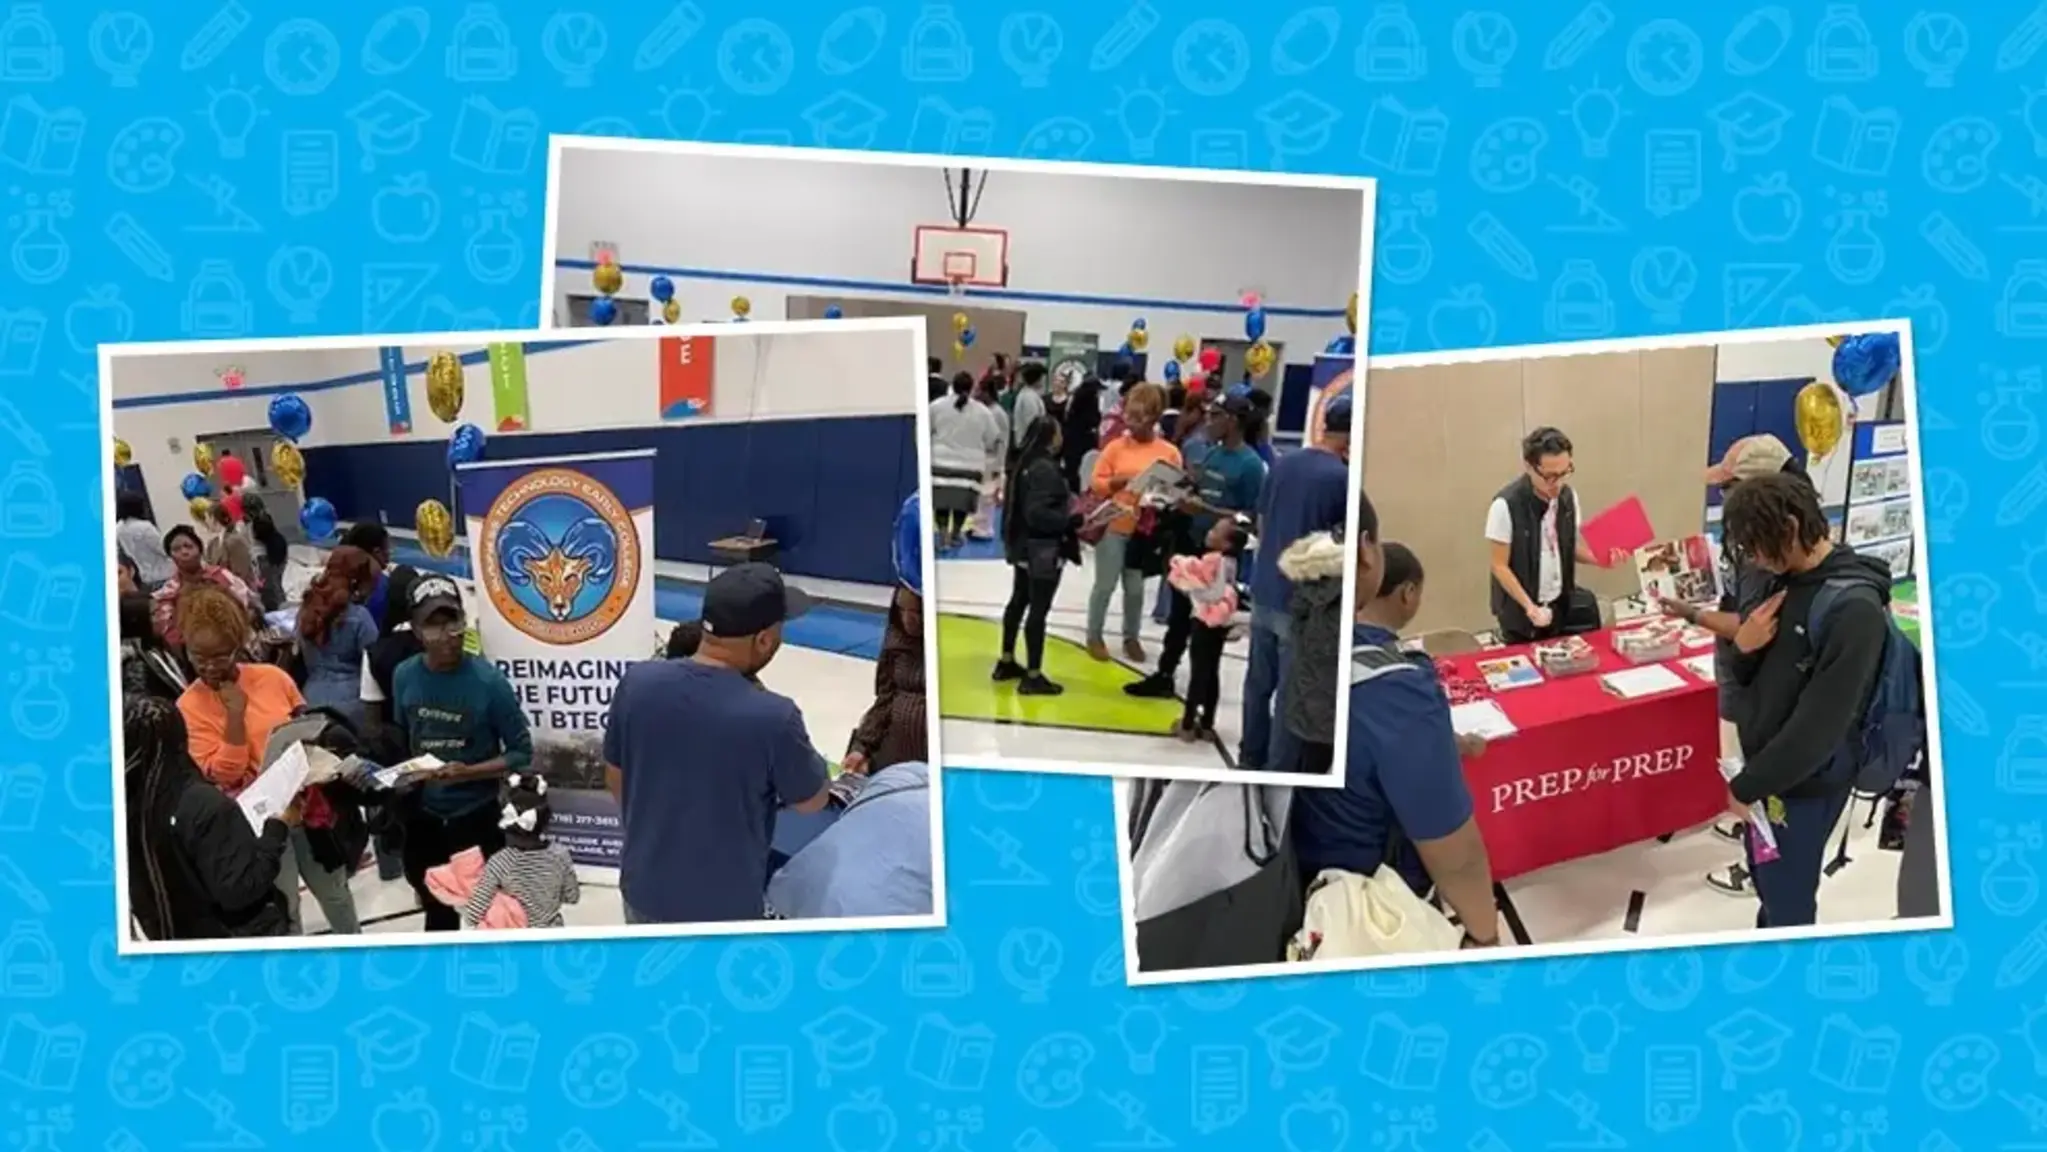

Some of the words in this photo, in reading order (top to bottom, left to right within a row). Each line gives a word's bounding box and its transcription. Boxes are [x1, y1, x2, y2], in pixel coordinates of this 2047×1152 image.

[496, 475, 579, 517] TECHNOLOGY
[581, 480, 619, 519] EARLY
[1491, 767, 1582, 813] PREP
[1580, 762, 1612, 791] for
[1610, 745, 1694, 785] PREP
